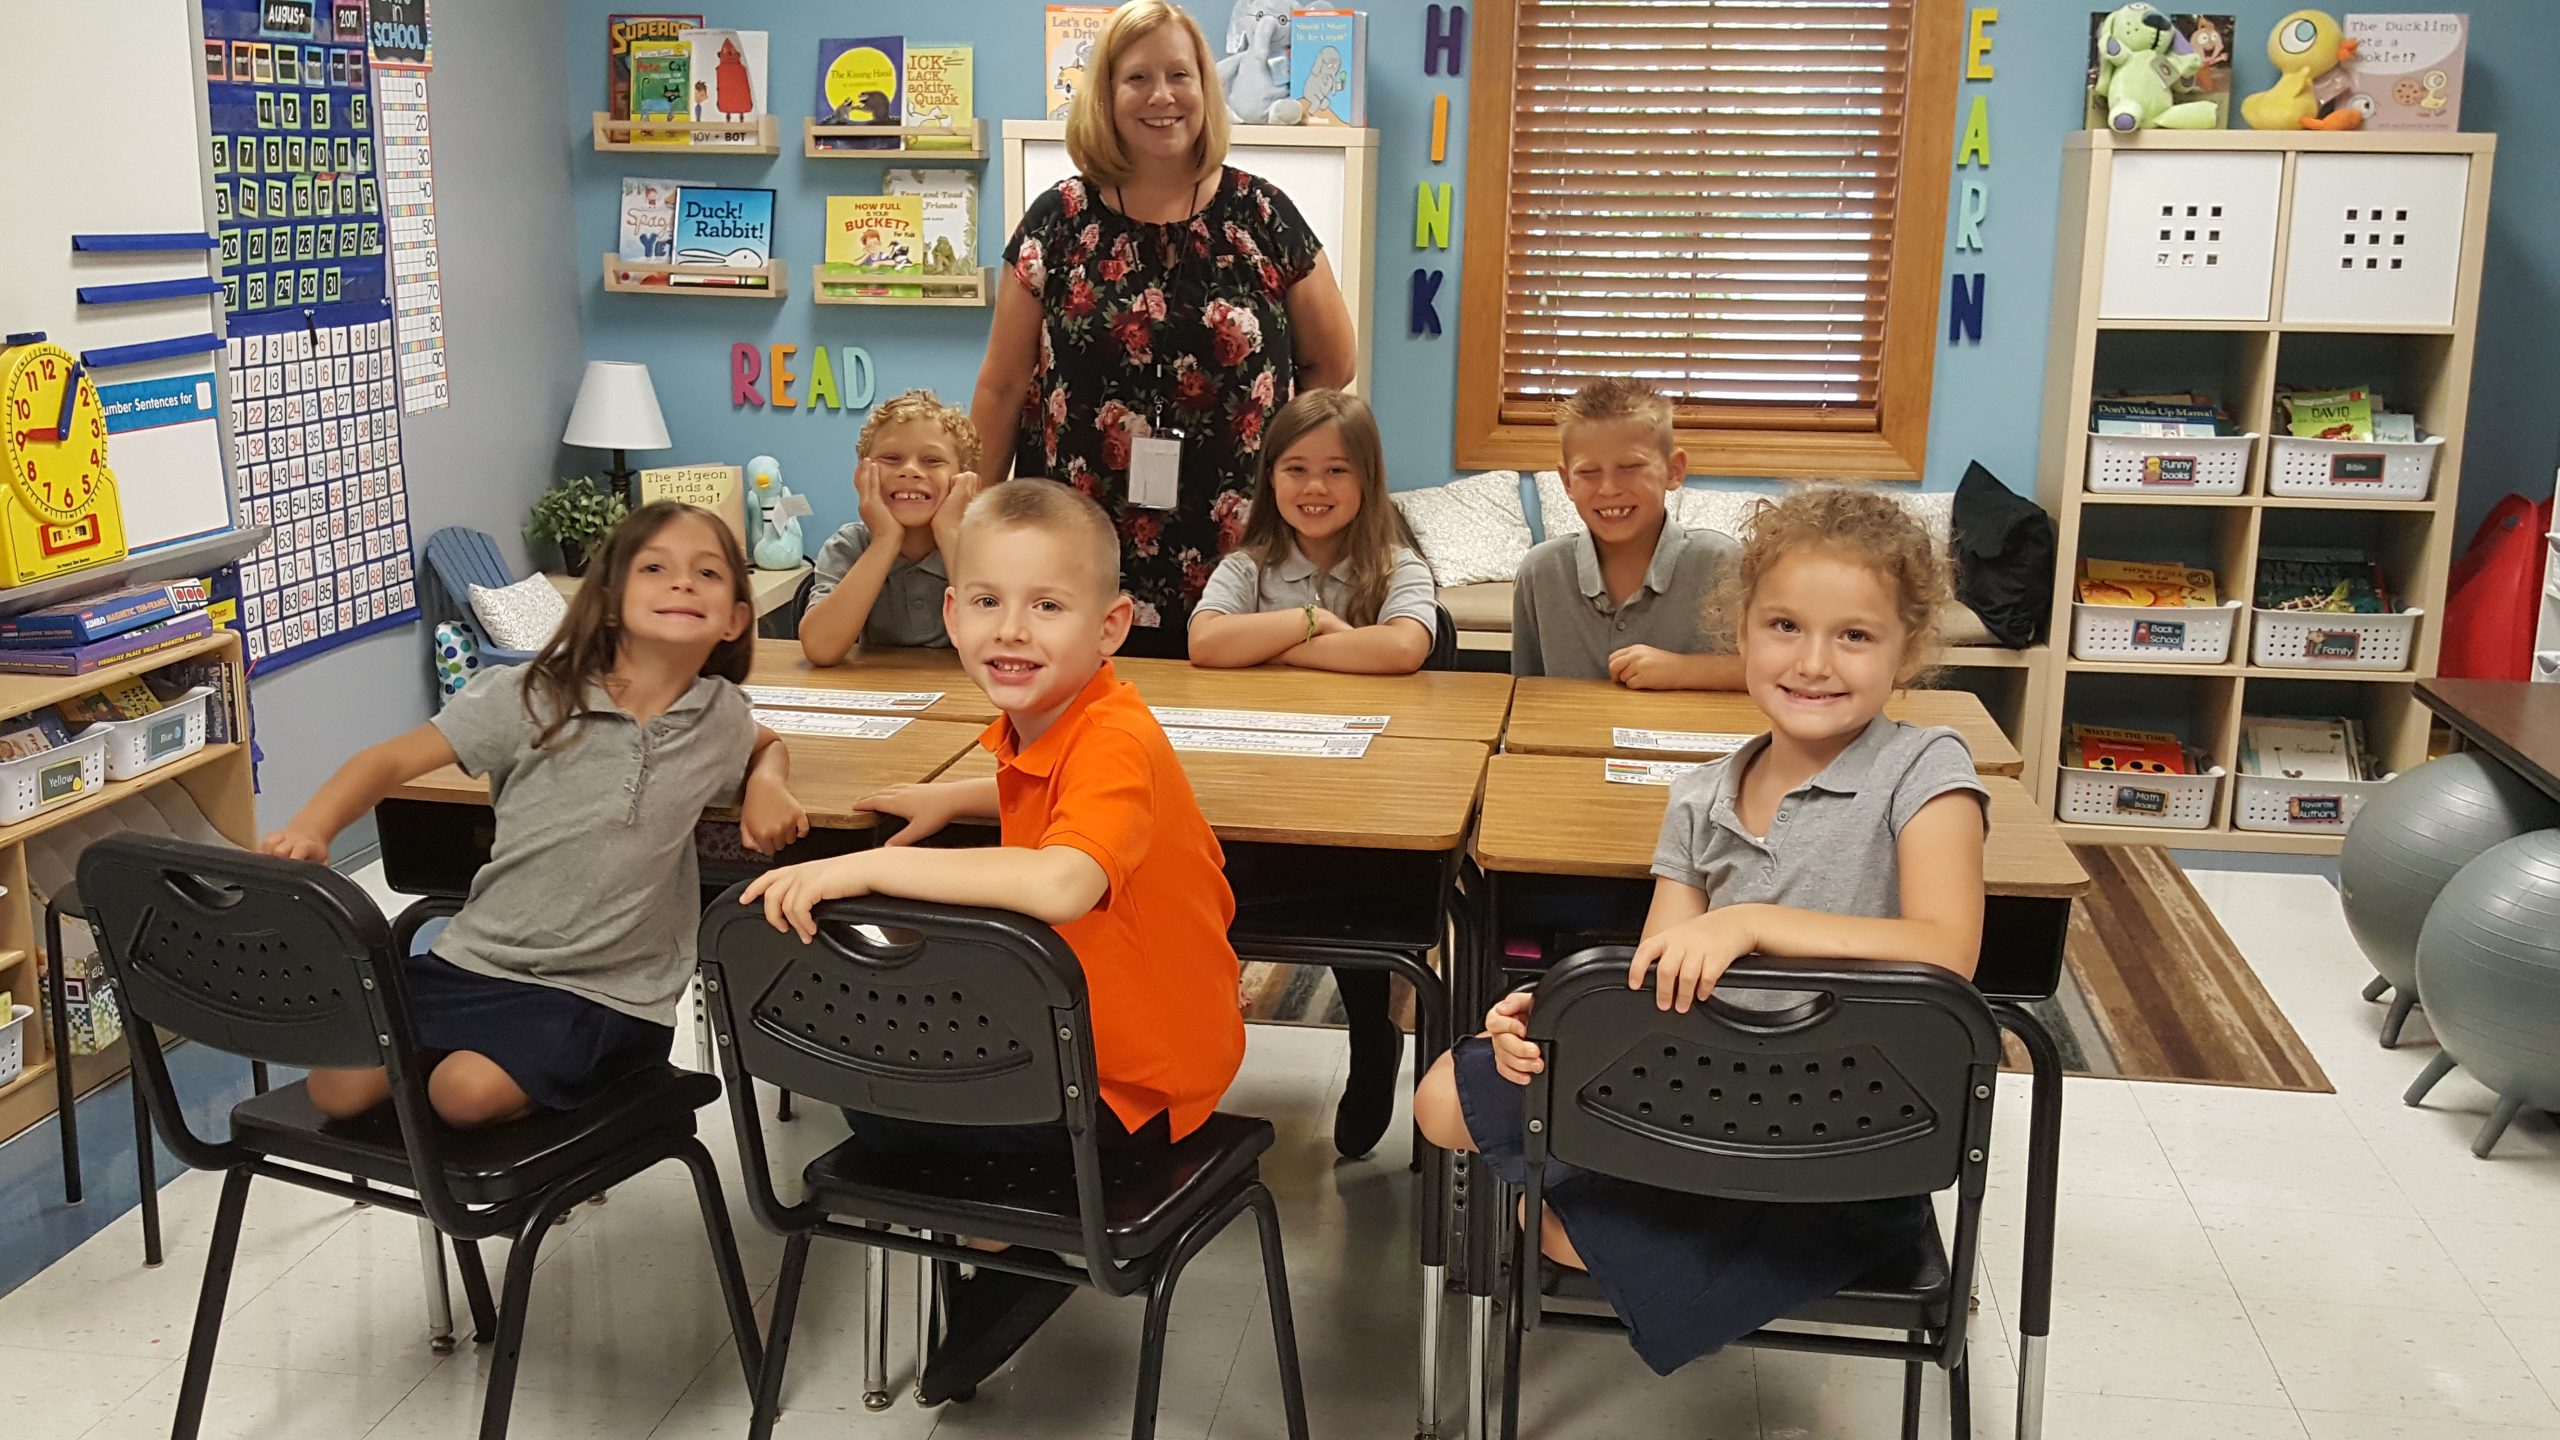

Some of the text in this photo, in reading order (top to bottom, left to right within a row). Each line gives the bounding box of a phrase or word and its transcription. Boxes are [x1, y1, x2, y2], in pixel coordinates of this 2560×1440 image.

[339, 9, 358, 28] 2017
[392, 4, 403, 22] in
[1052, 16, 1100, 29] Let's Go
[2350, 21, 2458, 35] The Duckling
[373, 21, 424, 50] SCHOOL
[1062, 28, 1097, 40] a Driv
[2358, 38, 2382, 47] ets
[668, 61, 687, 72] Cat
[908, 55, 948, 73] ICK,
[832, 70, 845, 79] The
[873, 69, 893, 78] Hand
[907, 70, 944, 82] LACK,
[415, 82, 424, 99] 10
[907, 83, 954, 96] ackity-
[914, 93, 959, 108] Quack
[264, 101, 362, 121] 1 2 3 5
[416, 115, 428, 131] 20
[725, 132, 746, 142] BOT
[214, 144, 367, 163] 6 7 8 9 10 11 12
[418, 149, 430, 166] 30
[244, 188, 254, 208] 14
[271, 189, 280, 208] 15
[298, 190, 307, 208] 16
[320, 190, 328, 207] 17
[343, 188, 351, 206] 18
[363, 186, 371, 205] 19
[420, 181, 431, 198] 40
[923, 191, 938, 199] and
[941, 191, 964, 199] Toad
[685, 201, 743, 219] Duck!
[855, 203, 901, 211] HOW FULL
[923, 201, 958, 210] Friends
[423, 219, 434, 235] 50
[694, 220, 764, 239] Rabbit!
[845, 218, 910, 232] BUCKET?
[223, 230, 376, 258] 20 21 22 23 24 25 26
[425, 251, 436, 267] 60
[223, 276, 337, 303] 27 28 29 30 31
[427, 284, 439, 301] 70
[429, 315, 442, 333] 80
[249, 342, 258, 360] 2
[271, 340, 279, 359] 3
[286, 338, 293, 354] 4
[302, 336, 309, 354] 5
[319, 334, 326, 351] 6
[336, 332, 344, 349] 7
[355, 330, 362, 347] 8
[370, 328, 376, 345] 9
[432, 351, 445, 368] 90
[40, 359, 56, 380] 12
[250, 364, 330, 392] 12 13 14 15 16
[732, 342, 876, 410] READ
[25, 371, 39, 392] 11
[80, 386, 90, 407] 2
[434, 384, 447, 399] 100
[14, 398, 31, 420] 10
[103, 392, 193, 417] umber Sentences for
[2099, 405, 2213, 418] Don't Wake Up Mama!
[2312, 406, 2350, 419] DAVID
[91, 418, 100, 439] 3
[16, 431, 25, 452] 9
[90, 448, 100, 468] 4
[2161, 460, 2192, 472] Funny
[27, 460, 37, 481] 8
[646, 470, 727, 483] The Pigeon
[2162, 471, 2191, 480] books
[43, 482, 51, 502] 7
[81, 474, 91, 495] 5
[660, 483, 701, 494] Finds
[64, 488, 73, 508] 6
[689, 492, 720, 504] Dog!
[85, 616, 106, 629] JUMBO
[106, 607, 136, 623] MAGNETIC
[2151, 624, 2174, 633] Back
[2150, 634, 2181, 644] School
[125, 649, 142, 660] PLACE
[2322, 646, 2354, 656] Family
[128, 687, 150, 713] MES
[136, 684, 154, 702] MY
[120, 690, 145, 717] ROO
[160, 731, 173, 743] Blue
[48, 774, 75, 789] Yellow
[2135, 792, 2160, 802] Math
[2301, 801, 2334, 809] Favorite
[2299, 810, 2336, 819] Authors
